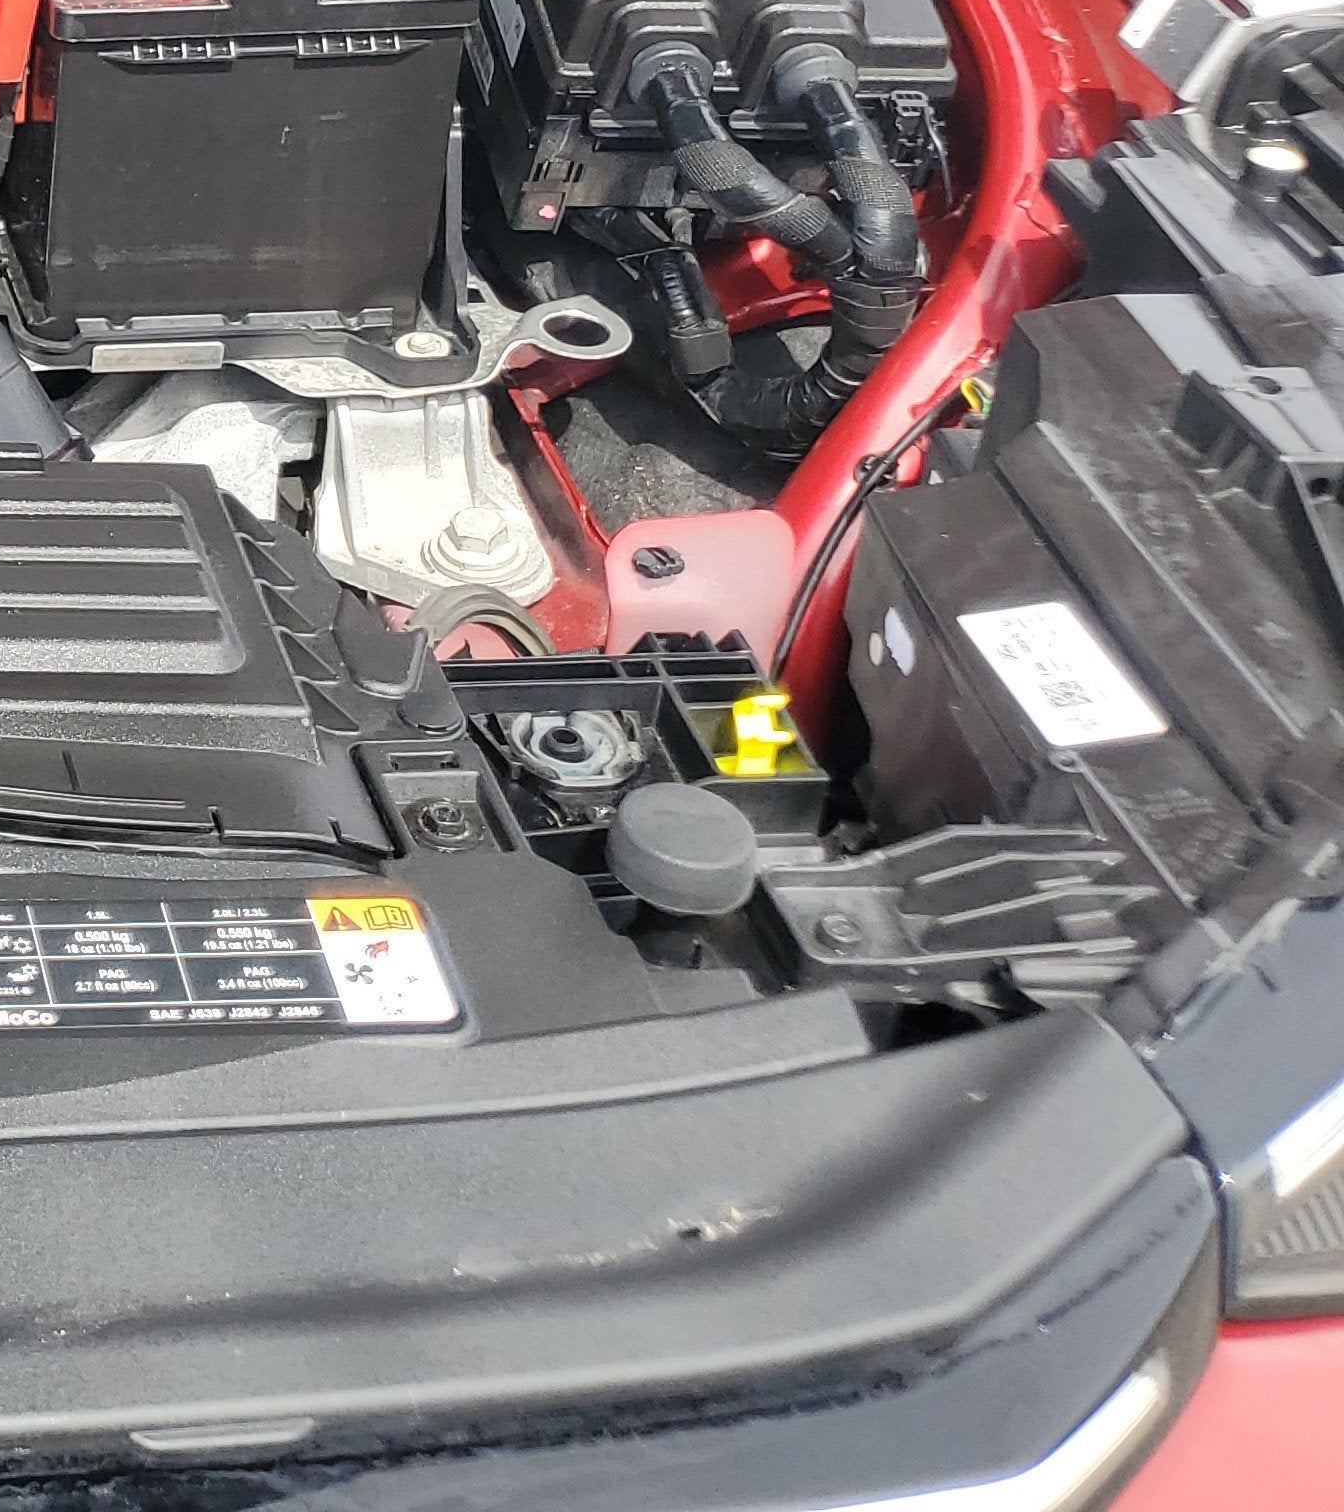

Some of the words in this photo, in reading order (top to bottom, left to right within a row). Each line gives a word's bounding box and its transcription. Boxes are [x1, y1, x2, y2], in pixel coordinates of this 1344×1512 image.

[111, 930, 130, 944] kg
[253, 926, 273, 940] kg
[98, 968, 126, 979] PAG
[242, 966, 271, 977] PAG
